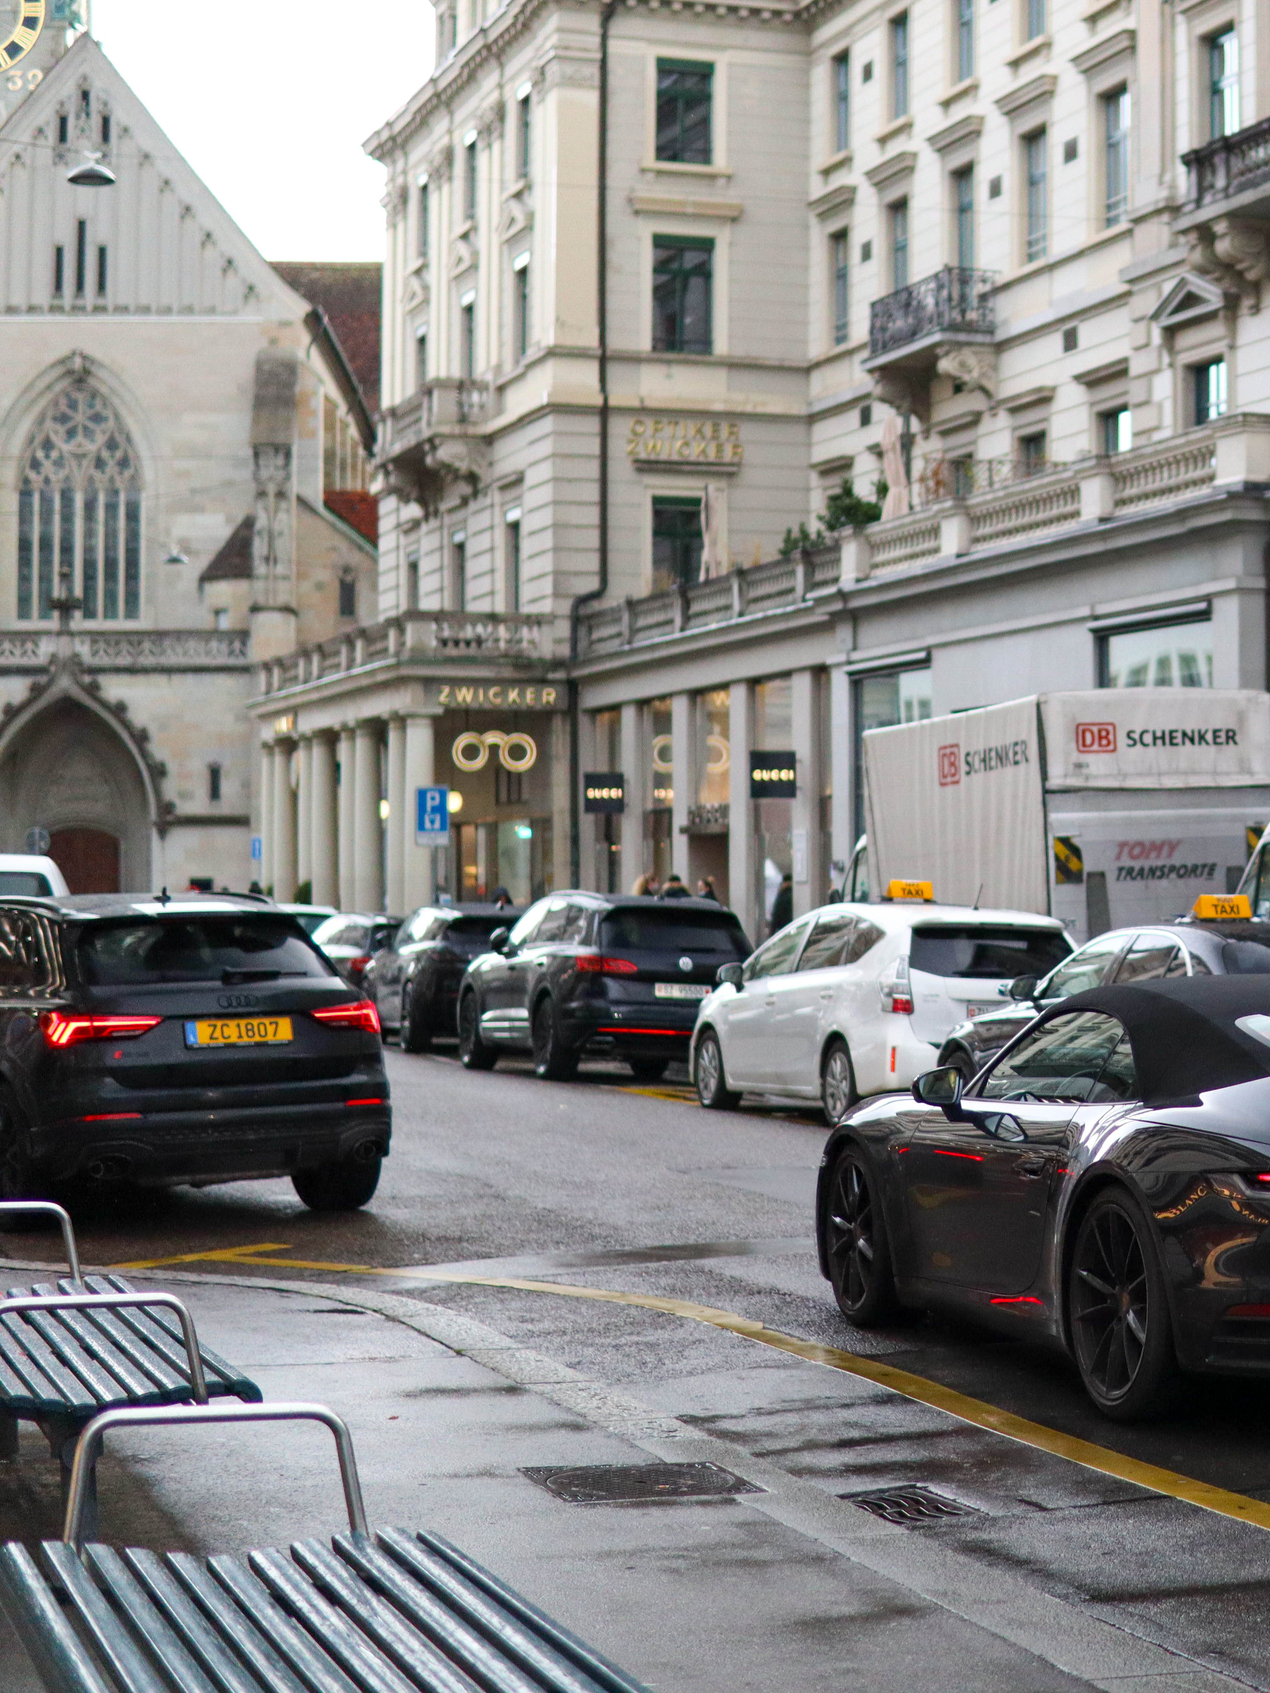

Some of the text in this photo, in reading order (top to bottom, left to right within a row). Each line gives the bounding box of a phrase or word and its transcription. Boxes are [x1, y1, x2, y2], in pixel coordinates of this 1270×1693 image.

[630, 419, 740, 440] OPTIKER
[626, 438, 744, 460] ZWICKER
[438, 685, 557, 705] ZWICKER
[1080, 727, 1239, 749] DB SCHENKER
[963, 739, 1030, 776] SCHENKER
[752, 768, 795, 782] GUCCI
[425, 791, 440, 815] P
[586, 787, 623, 800] GUCCI
[1114, 840, 1182, 861] TOMY
[1115, 863, 1217, 882] TRANSPORTE
[900, 887, 924, 897] TAXI
[1212, 904, 1240, 915] TAXI
[207, 1021, 279, 1041] ZC 1807
